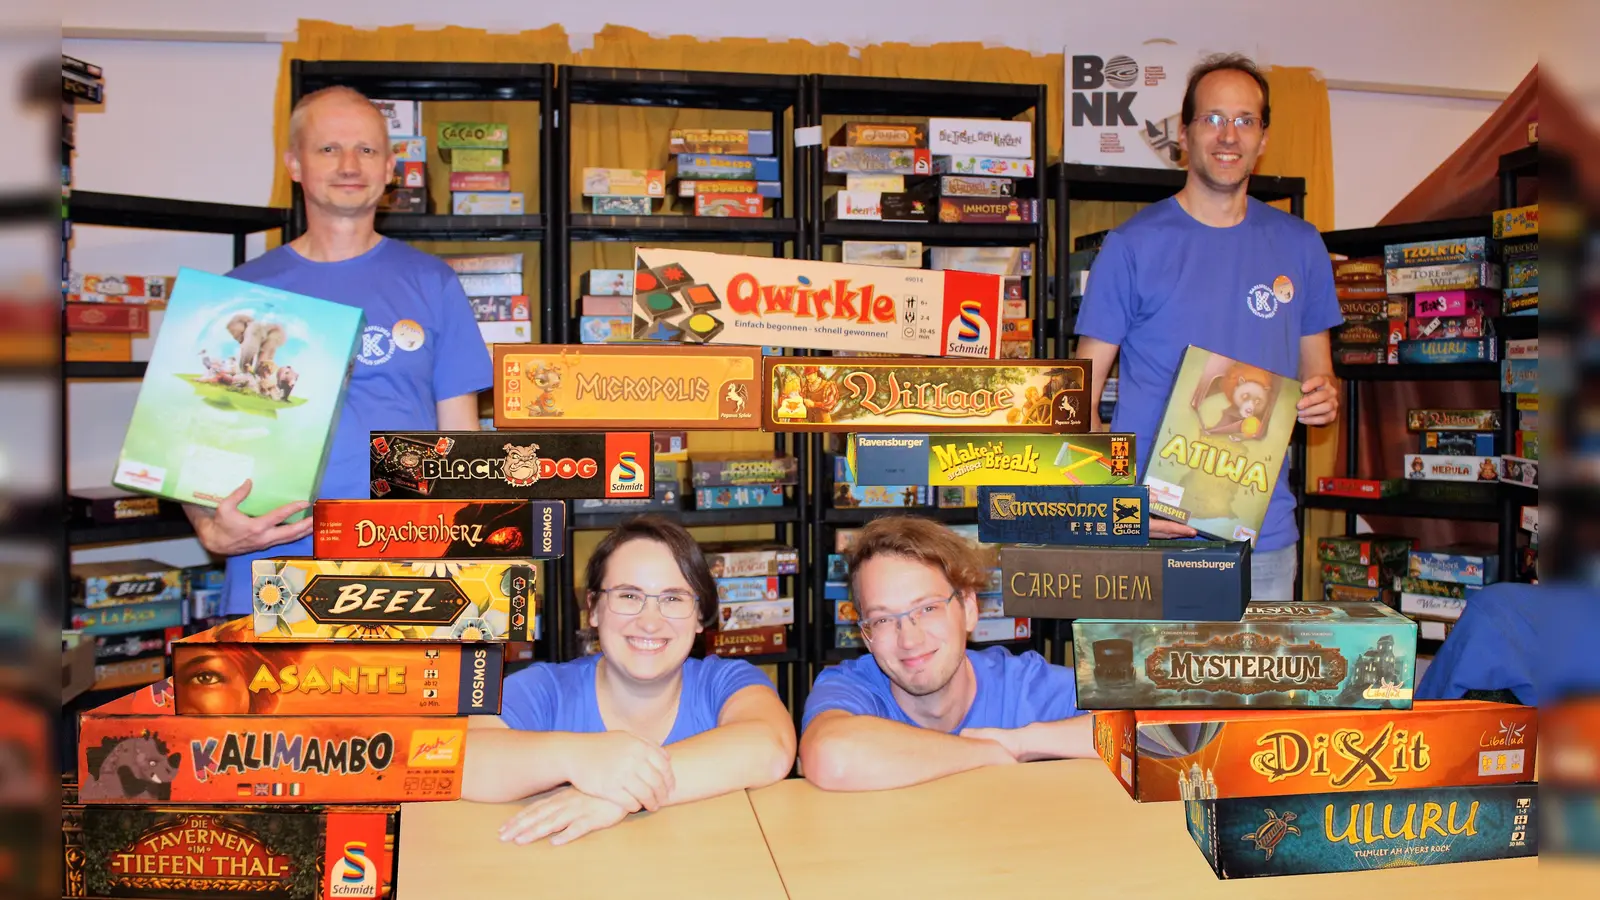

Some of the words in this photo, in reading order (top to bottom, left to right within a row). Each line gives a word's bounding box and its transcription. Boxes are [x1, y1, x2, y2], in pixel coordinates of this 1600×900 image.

[1072, 92, 1138, 126] NK
[442, 127, 485, 140] CACAO
[963, 203, 1009, 214] IMHOTEP
[1411, 270, 1442, 279] TORE
[1430, 278, 1460, 288] WELT
[726, 271, 897, 325] Qwirkle
[734, 318, 765, 330] Einfach
[766, 321, 808, 334] begonnen
[814, 324, 842, 335] schnell
[843, 327, 889, 340] gewonnen!
[362, 333, 385, 357] K
[948, 343, 988, 355] Schmidt
[575, 372, 710, 402] MICROPOLIS
[843, 370, 1015, 416] Village
[858, 436, 924, 449] Ravensburger
[422, 458, 506, 480] BLACK
[539, 457, 598, 480] DOG
[932, 441, 987, 472] Make
[985, 448, 1040, 473] Break
[1160, 433, 1269, 493] ATIWA
[947, 460, 982, 481] architect
[611, 482, 644, 492] Schmidt
[990, 496, 1108, 520] Carcassonne
[1149, 502, 1187, 520] NERSPIEL
[542, 506, 552, 552] KOSMOS
[1113, 527, 1140, 535] GLÜCK
[1167, 558, 1235, 571] Ravensburger
[115, 578, 157, 597] BEEZ
[328, 583, 437, 614] BEEZ
[1011, 572, 1082, 599] CARPE
[1095, 574, 1152, 601] DIEM
[248, 664, 407, 695] ASANTE
[471, 649, 486, 708] KOSMOS
[1169, 651, 1325, 686] MYSTERIUM
[191, 732, 394, 782] KALIMAMBO
[191, 819, 208, 829] DIE
[1323, 800, 1480, 845] ULURU
[144, 829, 255, 857] TAVERNEN
[1353, 848, 1389, 857] TUMULT
[1404, 846, 1428, 854] AYERS
[1430, 844, 1450, 853] ROCK
[332, 884, 374, 897] Schmidt
